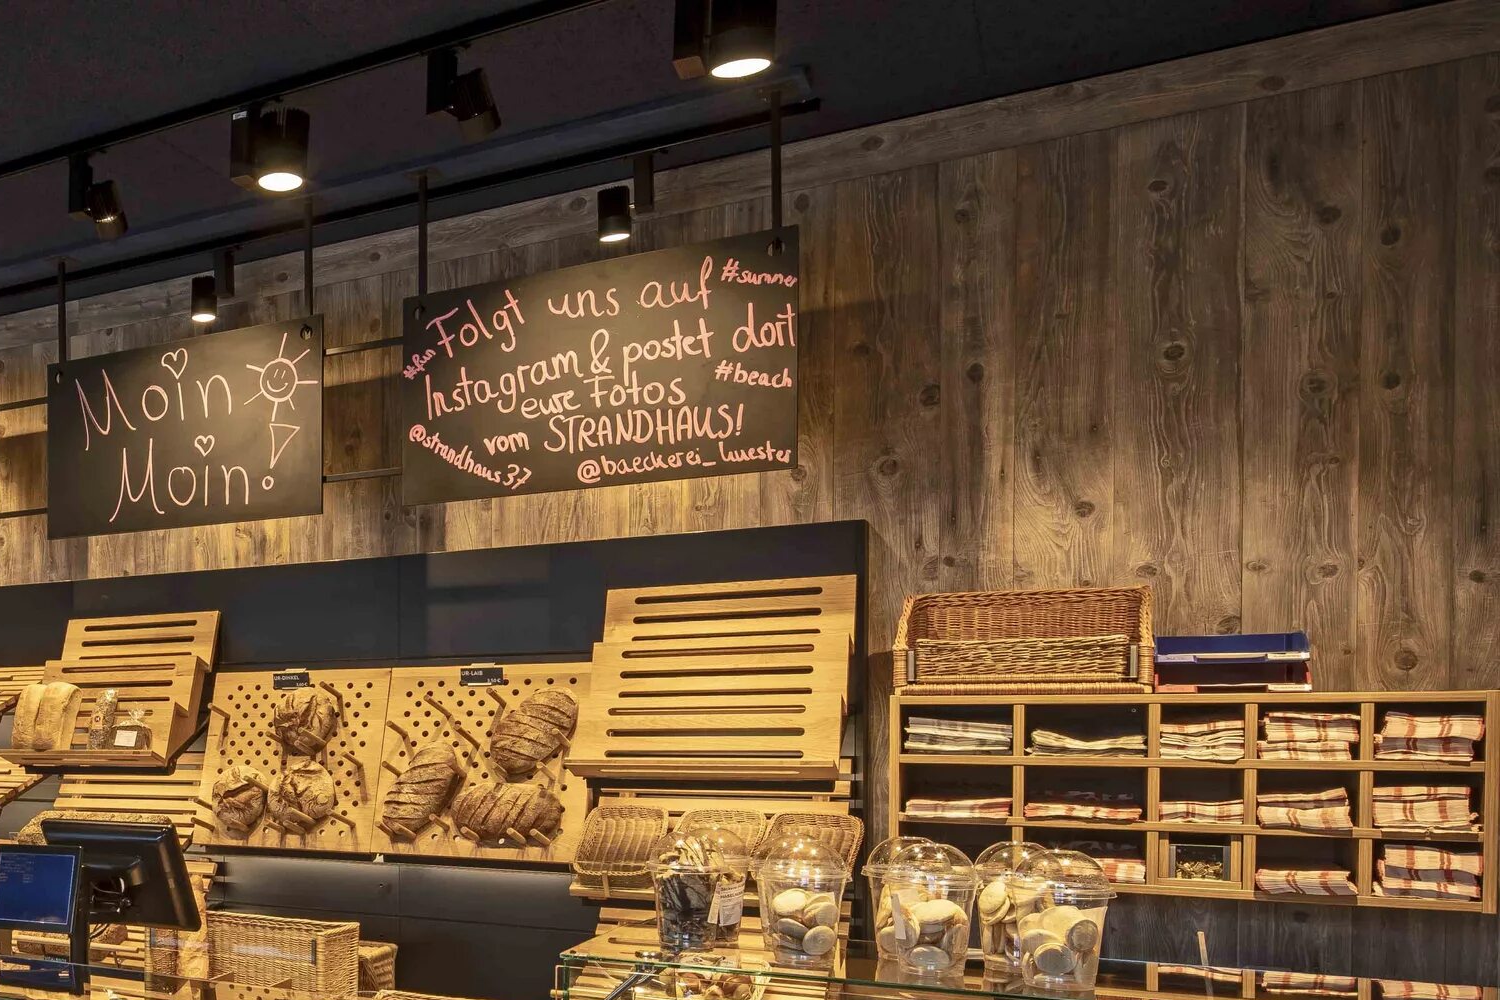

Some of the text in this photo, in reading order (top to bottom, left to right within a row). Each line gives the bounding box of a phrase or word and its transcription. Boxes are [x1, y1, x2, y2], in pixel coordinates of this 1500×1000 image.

[721, 257, 798, 288] #summer
[425, 255, 715, 359] Folgt uns auf
[402, 347, 437, 381] #fun
[424, 302, 797, 421] Instagram & postet dort
[714, 358, 793, 389] #beach
[75, 350, 232, 451] Moin
[520, 374, 687, 420] eure Fotos
[483, 402, 745, 457] vom STRANDHAUS!
